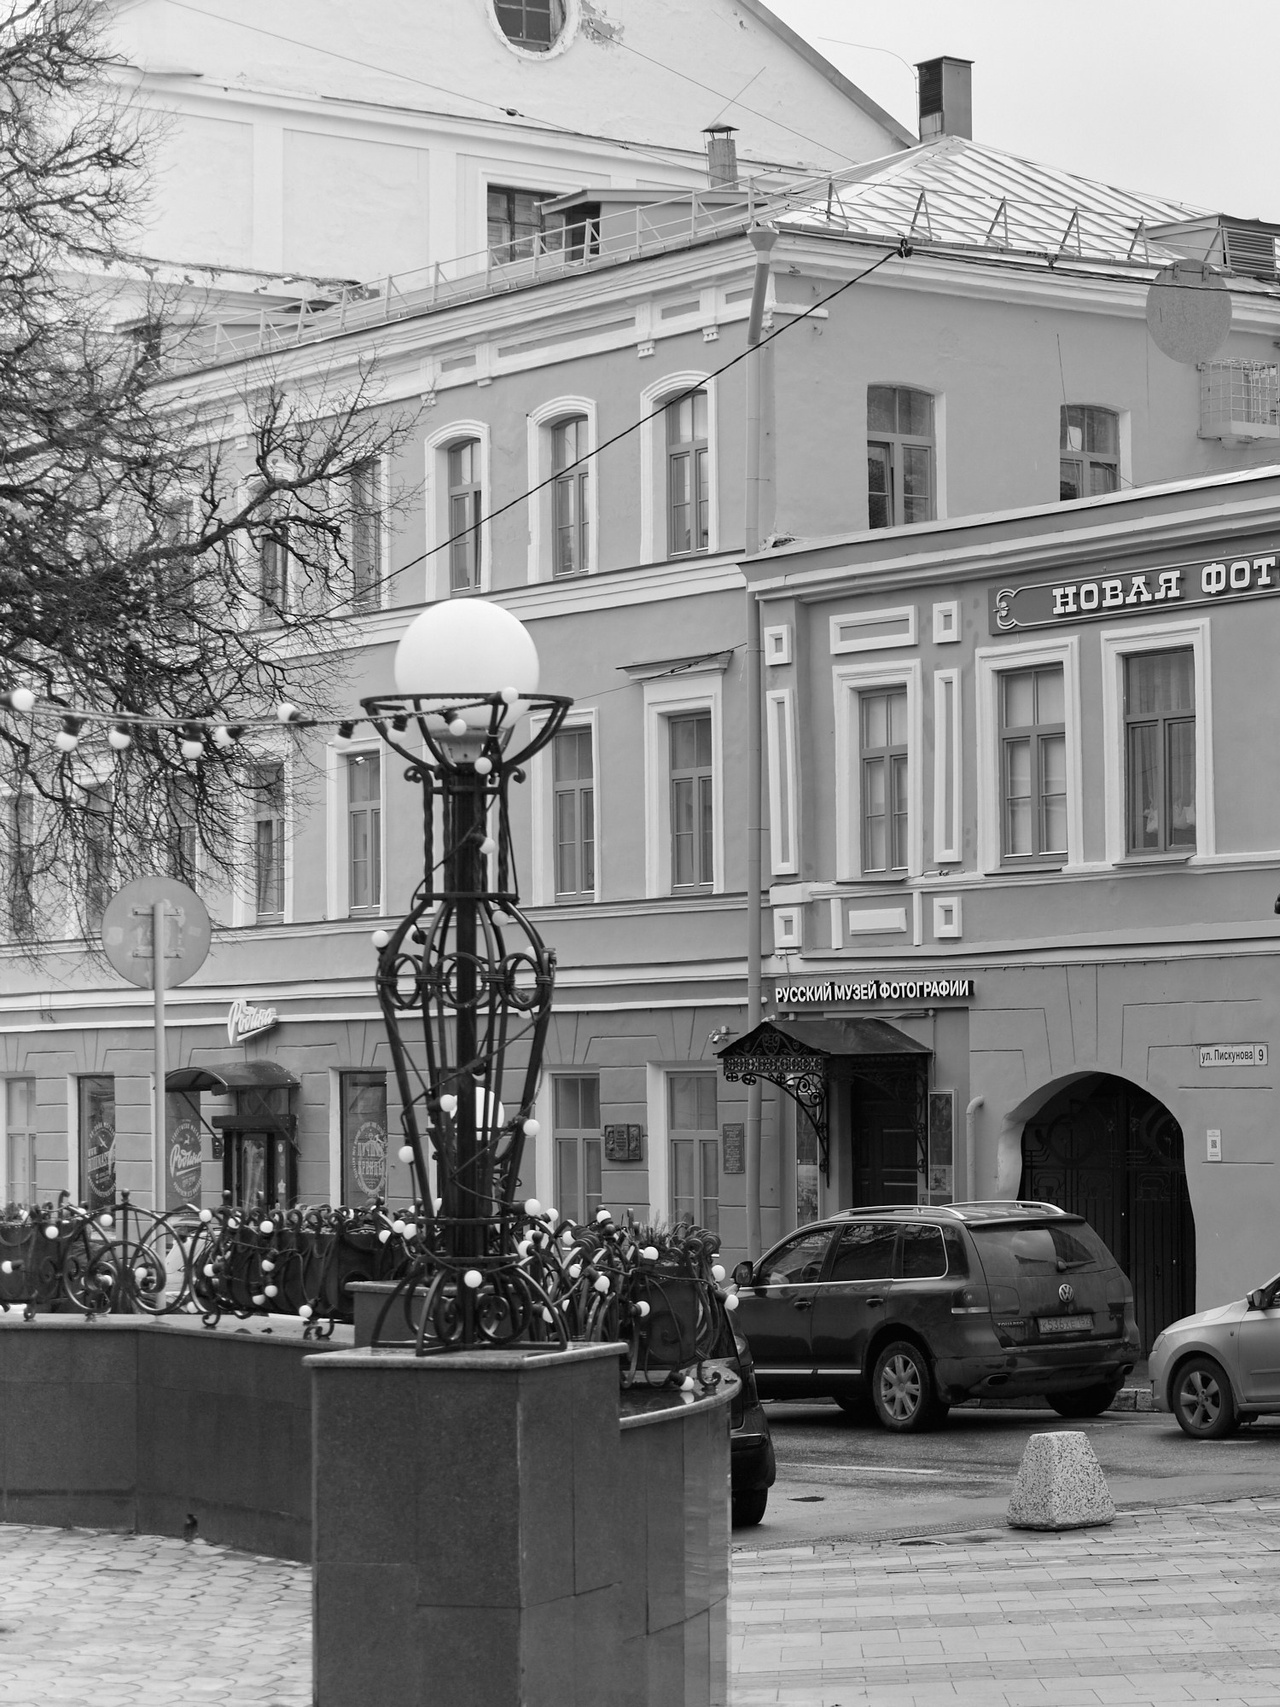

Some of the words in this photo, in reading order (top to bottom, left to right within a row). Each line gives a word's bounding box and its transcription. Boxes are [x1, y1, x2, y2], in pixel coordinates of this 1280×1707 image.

[1052, 569, 1182, 616] НОВАЯ
[775, 982, 833, 1004] РУССКИЙ
[834, 980, 877, 1001] МУЗЕЙ
[879, 979, 970, 999] ФОТОГРАФИИ
[1201, 1051, 1213, 1064] ул.
[1214, 1049, 1254, 1063] Пискунова
[1258, 1049, 1264, 1061] 9
